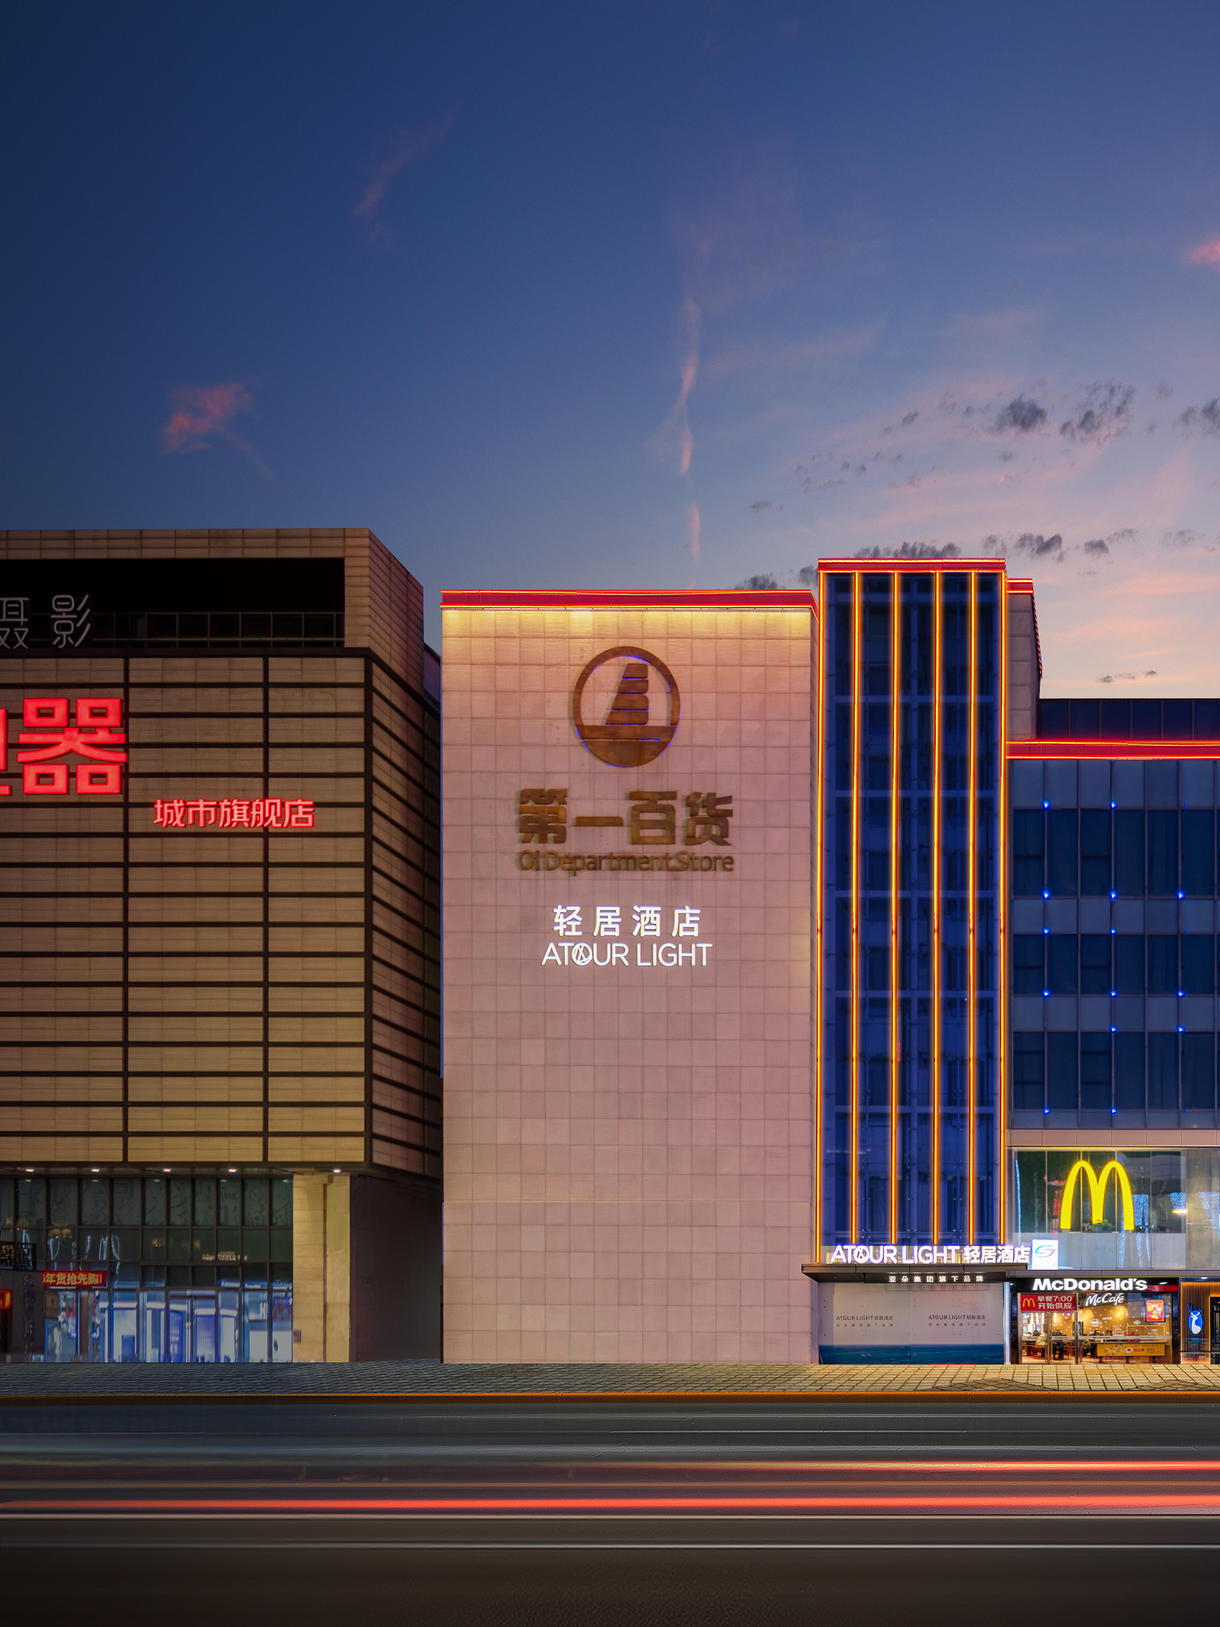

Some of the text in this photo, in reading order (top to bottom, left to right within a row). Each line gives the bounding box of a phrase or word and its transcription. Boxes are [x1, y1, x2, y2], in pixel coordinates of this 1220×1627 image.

[0, 697, 128, 795] 器
[153, 799, 315, 828] 城市旗舰店
[517, 788, 734, 846] 第一百货
[544, 849, 669, 876] Department
[669, 850, 735, 871] Store
[553, 904, 701, 937] 轻居酒店
[541, 942, 713, 966] ATOUR LIGHT
[830, 1245, 1030, 1264] ATOUR LIGHT 轻居酒店
[1032, 1278, 1148, 1291] McDonald's
